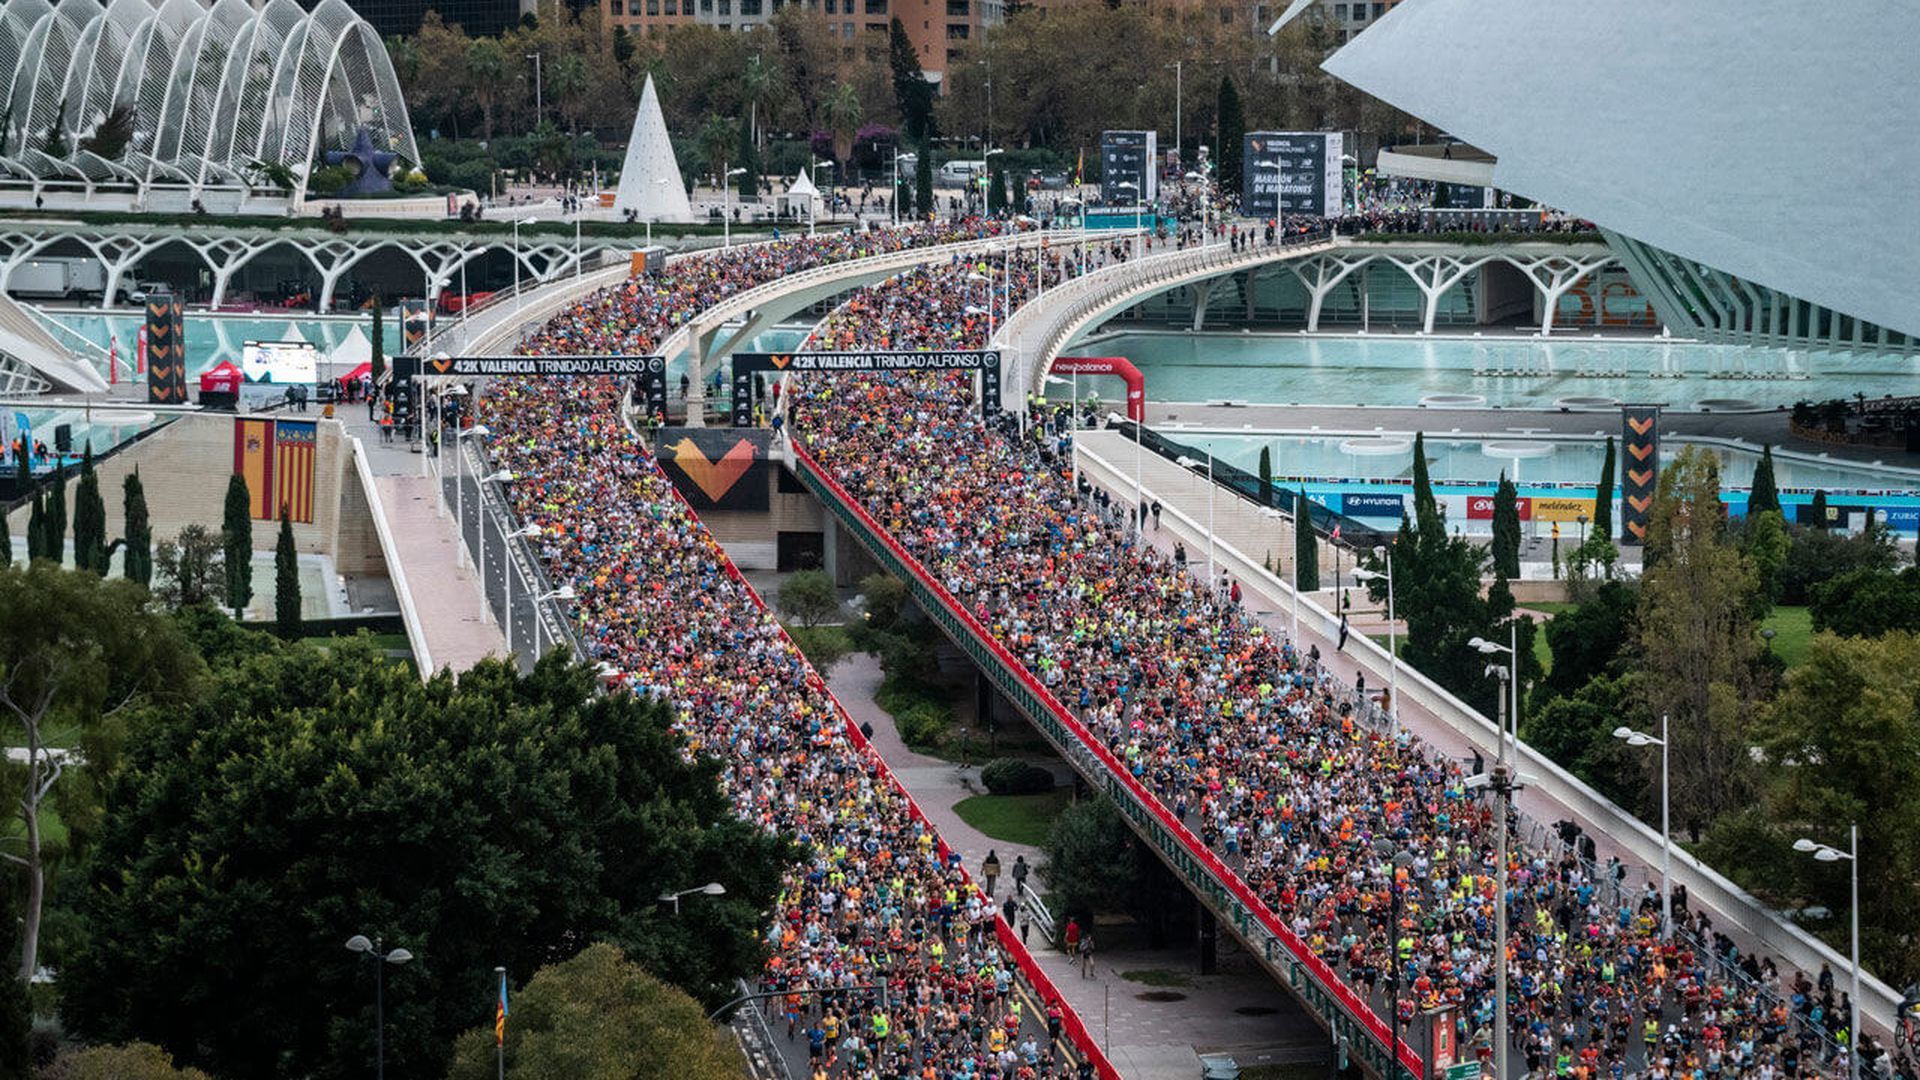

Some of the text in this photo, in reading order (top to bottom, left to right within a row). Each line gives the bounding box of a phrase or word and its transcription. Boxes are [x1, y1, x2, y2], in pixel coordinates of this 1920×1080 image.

[453, 359, 645, 373] 42K VALENCIA TRINIDAD ALFONSO
[793, 354, 980, 368] 42K VALENCIA TRINIDAD ALFONSO
